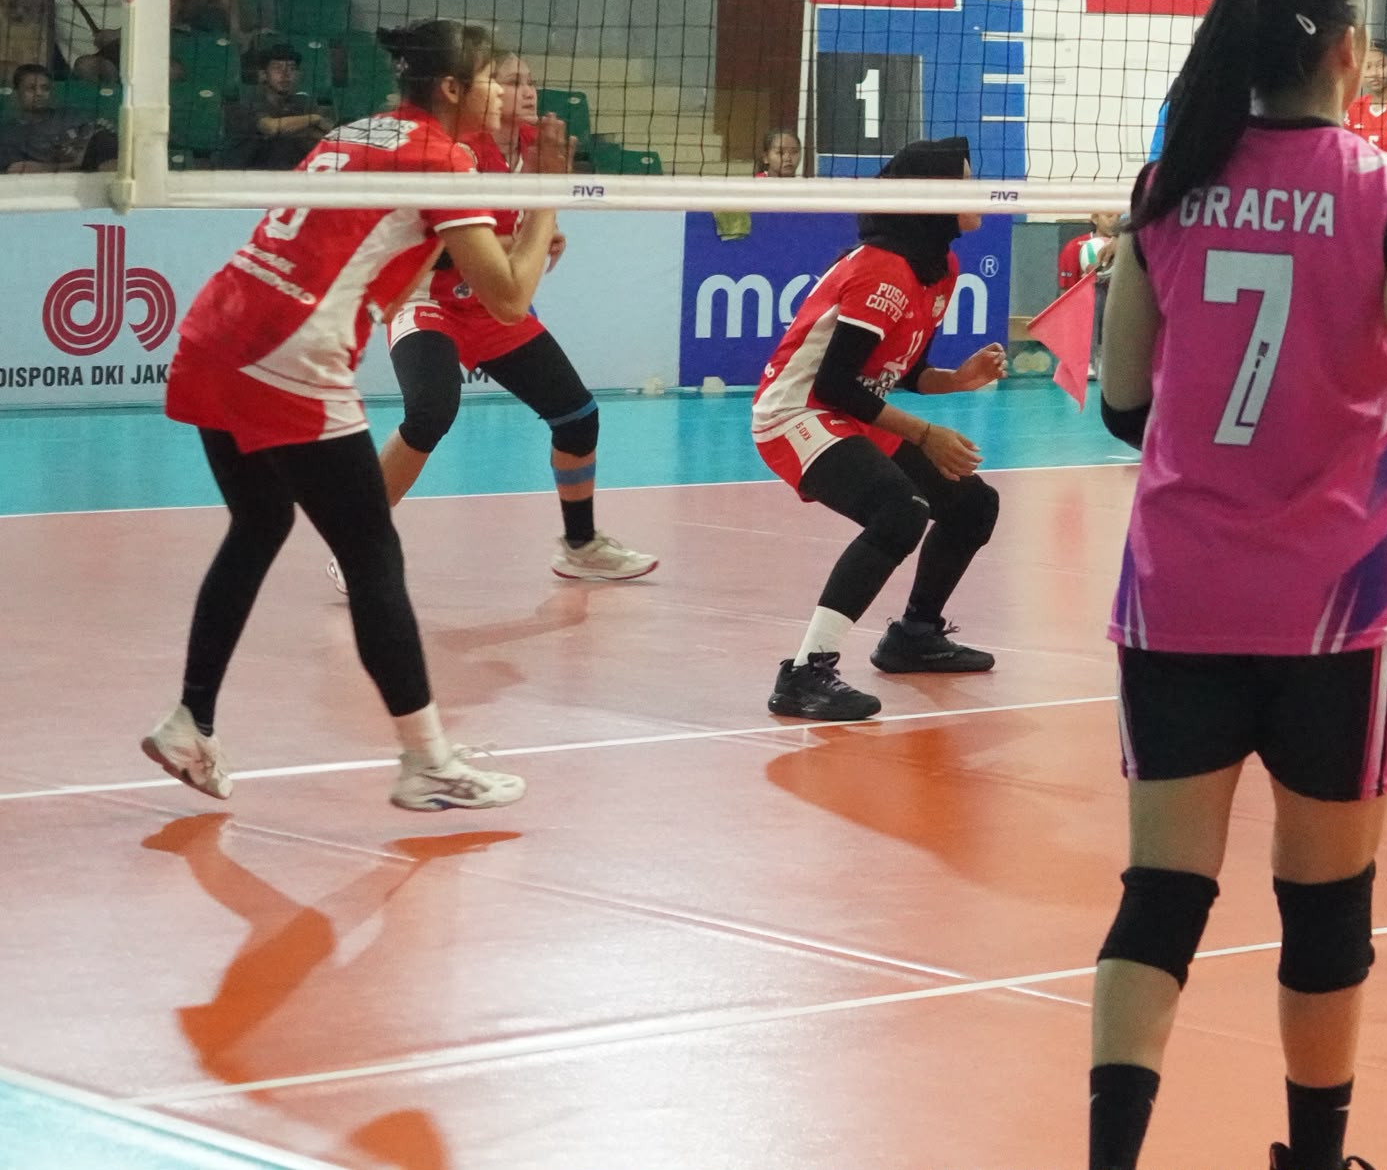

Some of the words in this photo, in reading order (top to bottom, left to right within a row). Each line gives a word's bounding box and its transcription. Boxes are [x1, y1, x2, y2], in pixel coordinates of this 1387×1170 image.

[855, 68, 880, 139] 1
[572, 185, 605, 197] FIVB
[990, 191, 1018, 201] FIVB
[1179, 185, 1336, 237] GRACYA
[1203, 249, 1294, 446] 7
[91, 364, 124, 385] DKI
[131, 363, 170, 385] JAK
